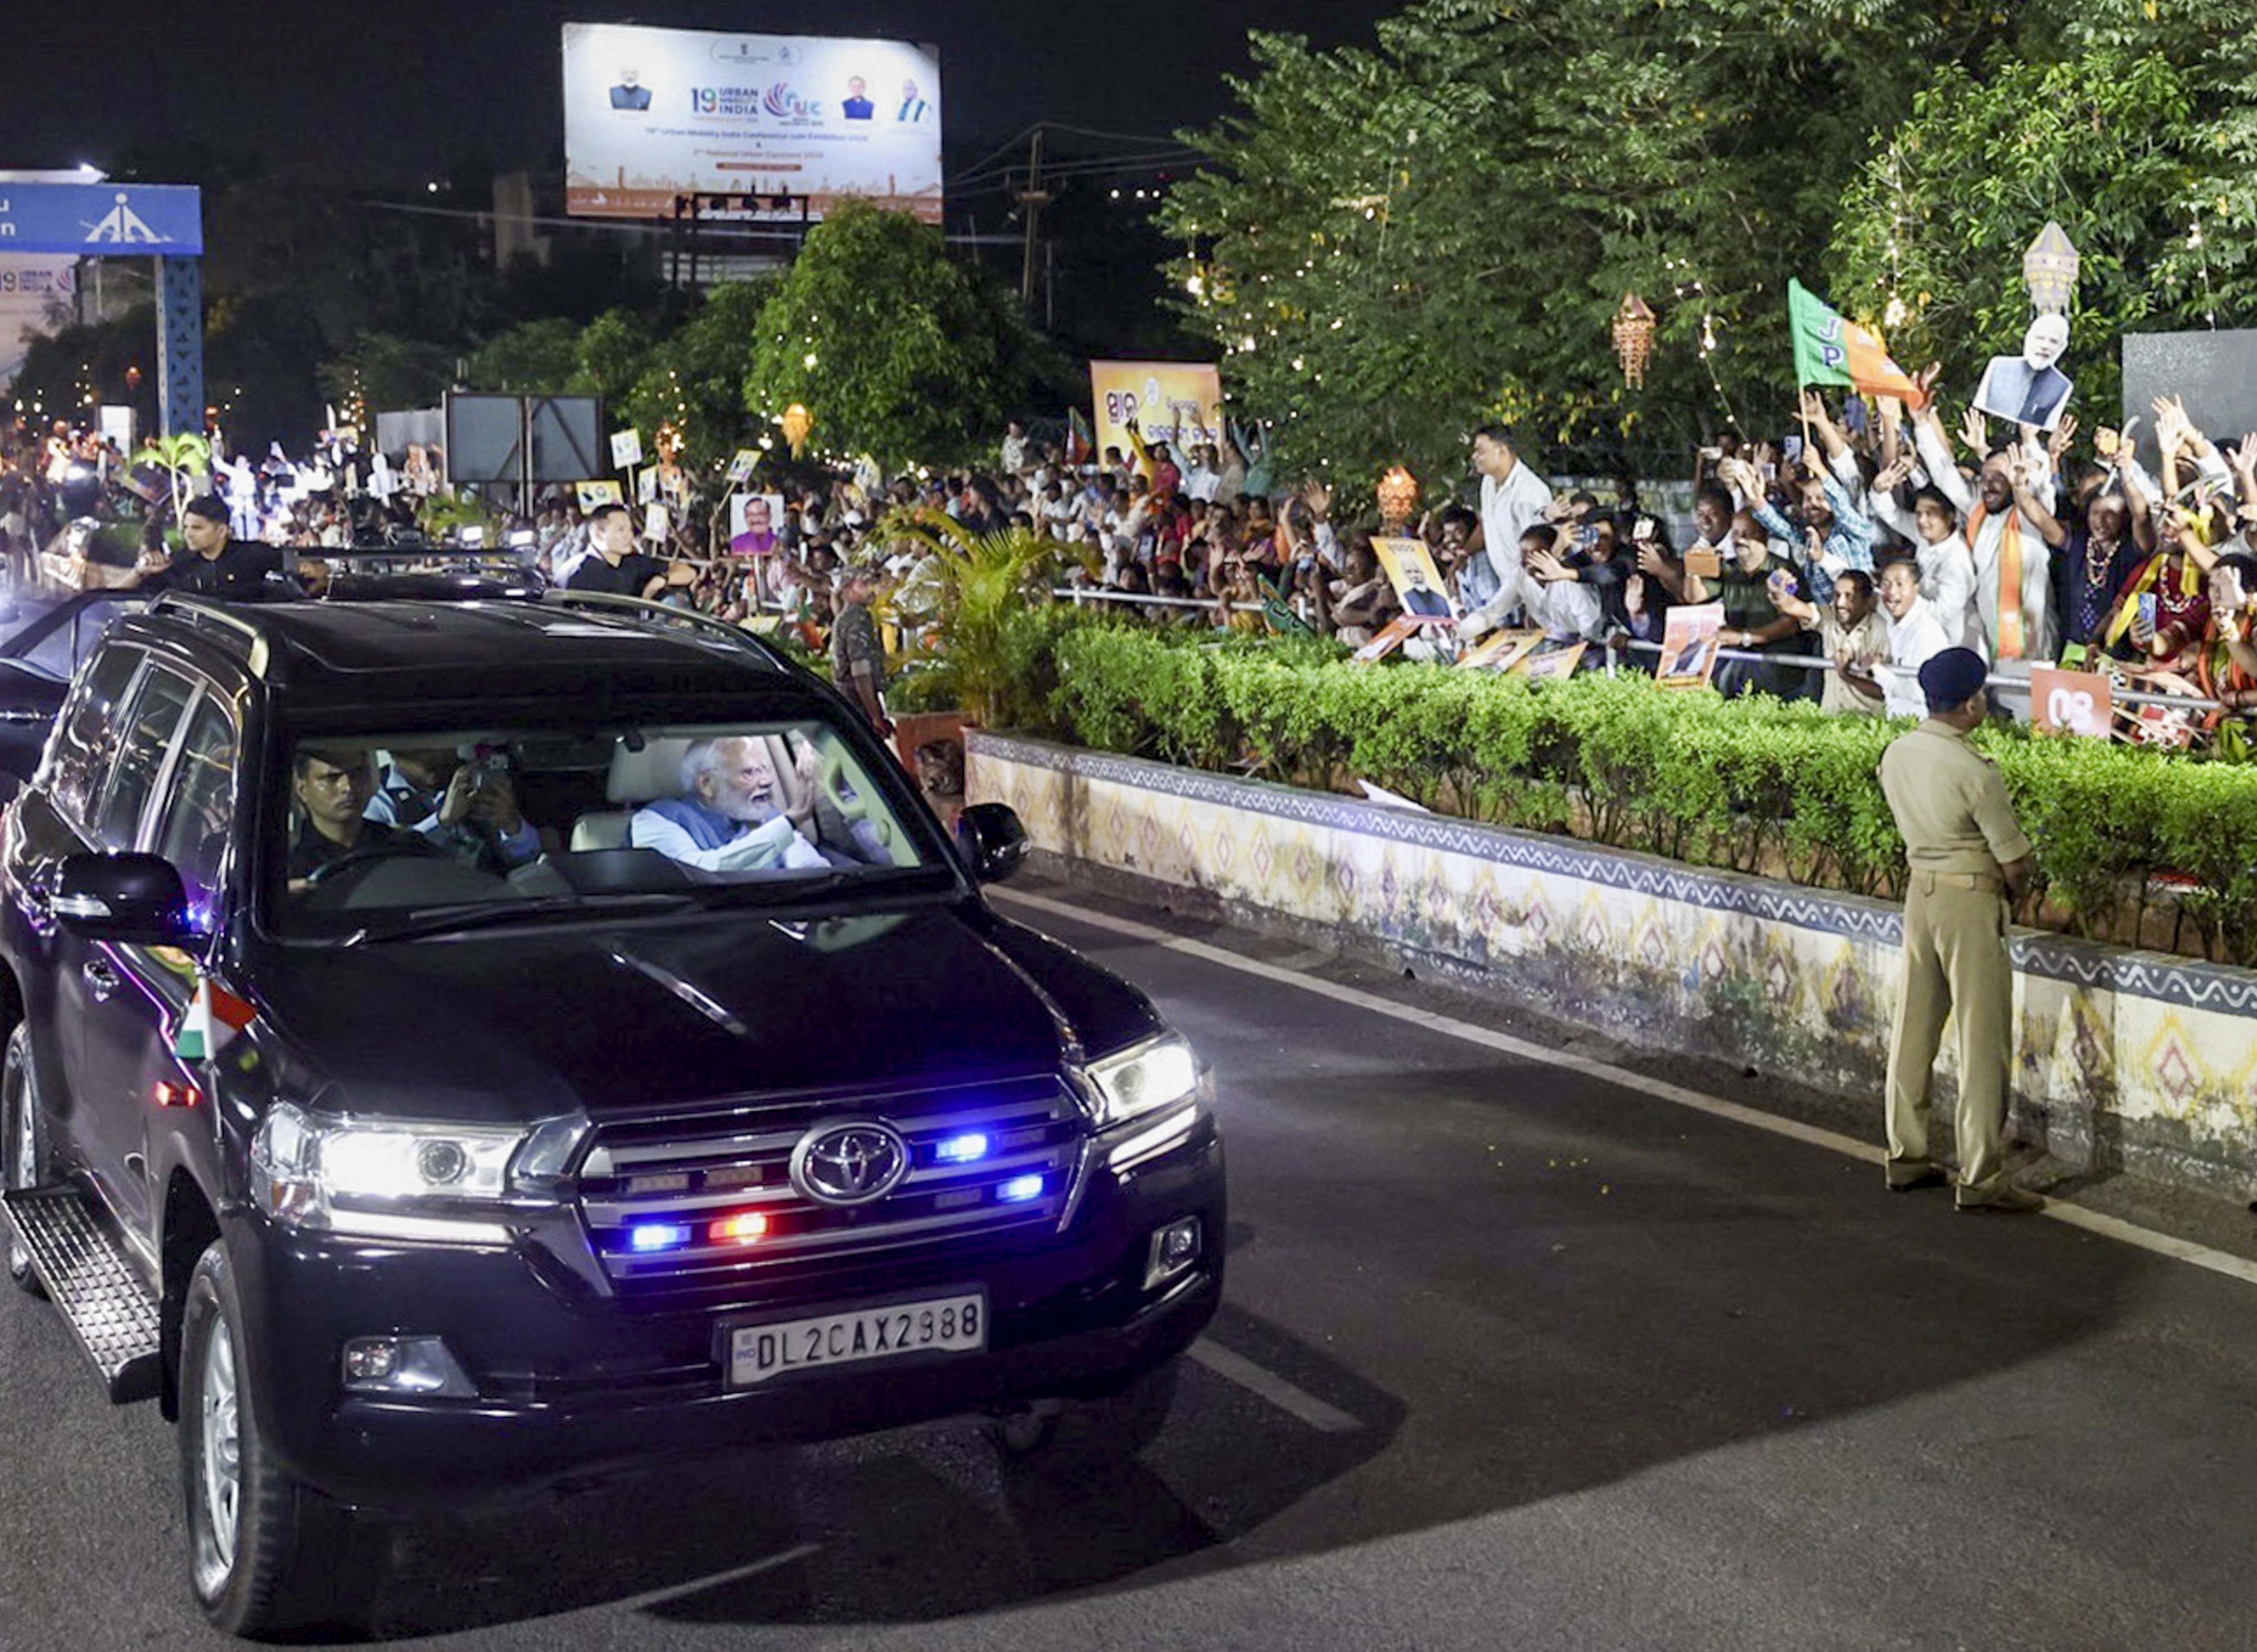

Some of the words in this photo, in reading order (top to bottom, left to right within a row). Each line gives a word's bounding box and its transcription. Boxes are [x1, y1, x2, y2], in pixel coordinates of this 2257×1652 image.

[691, 88, 717, 113] 19
[720, 88, 758, 97] URBAN
[720, 105, 758, 115] INDIA
[758, 1303, 978, 1370] DL2CAX2988
